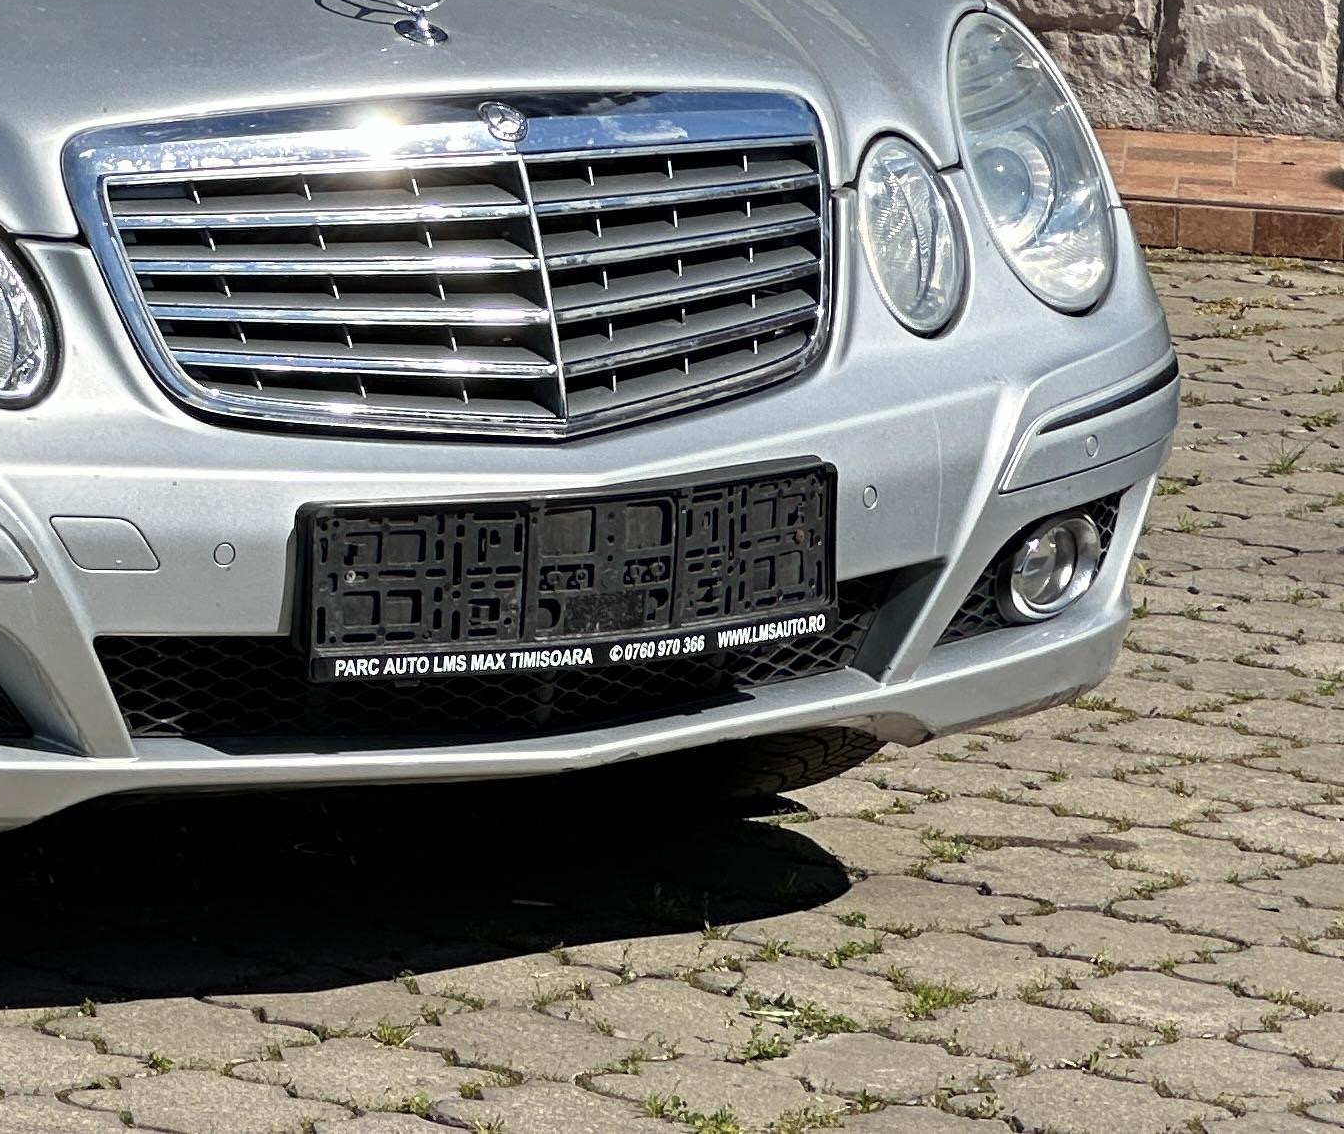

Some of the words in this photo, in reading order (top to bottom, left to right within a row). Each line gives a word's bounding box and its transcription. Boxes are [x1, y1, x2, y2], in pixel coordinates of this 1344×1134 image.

[334, 659, 380, 677] PARC
[382, 656, 430, 675] AUTO
[433, 654, 466, 673] LMS
[470, 652, 506, 672] MAX
[510, 647, 594, 669] TIMISOARA
[657, 637, 681, 657] 970
[682, 634, 706, 654] 366
[717, 613, 826, 649] WWW.LMSAUTO.RO
